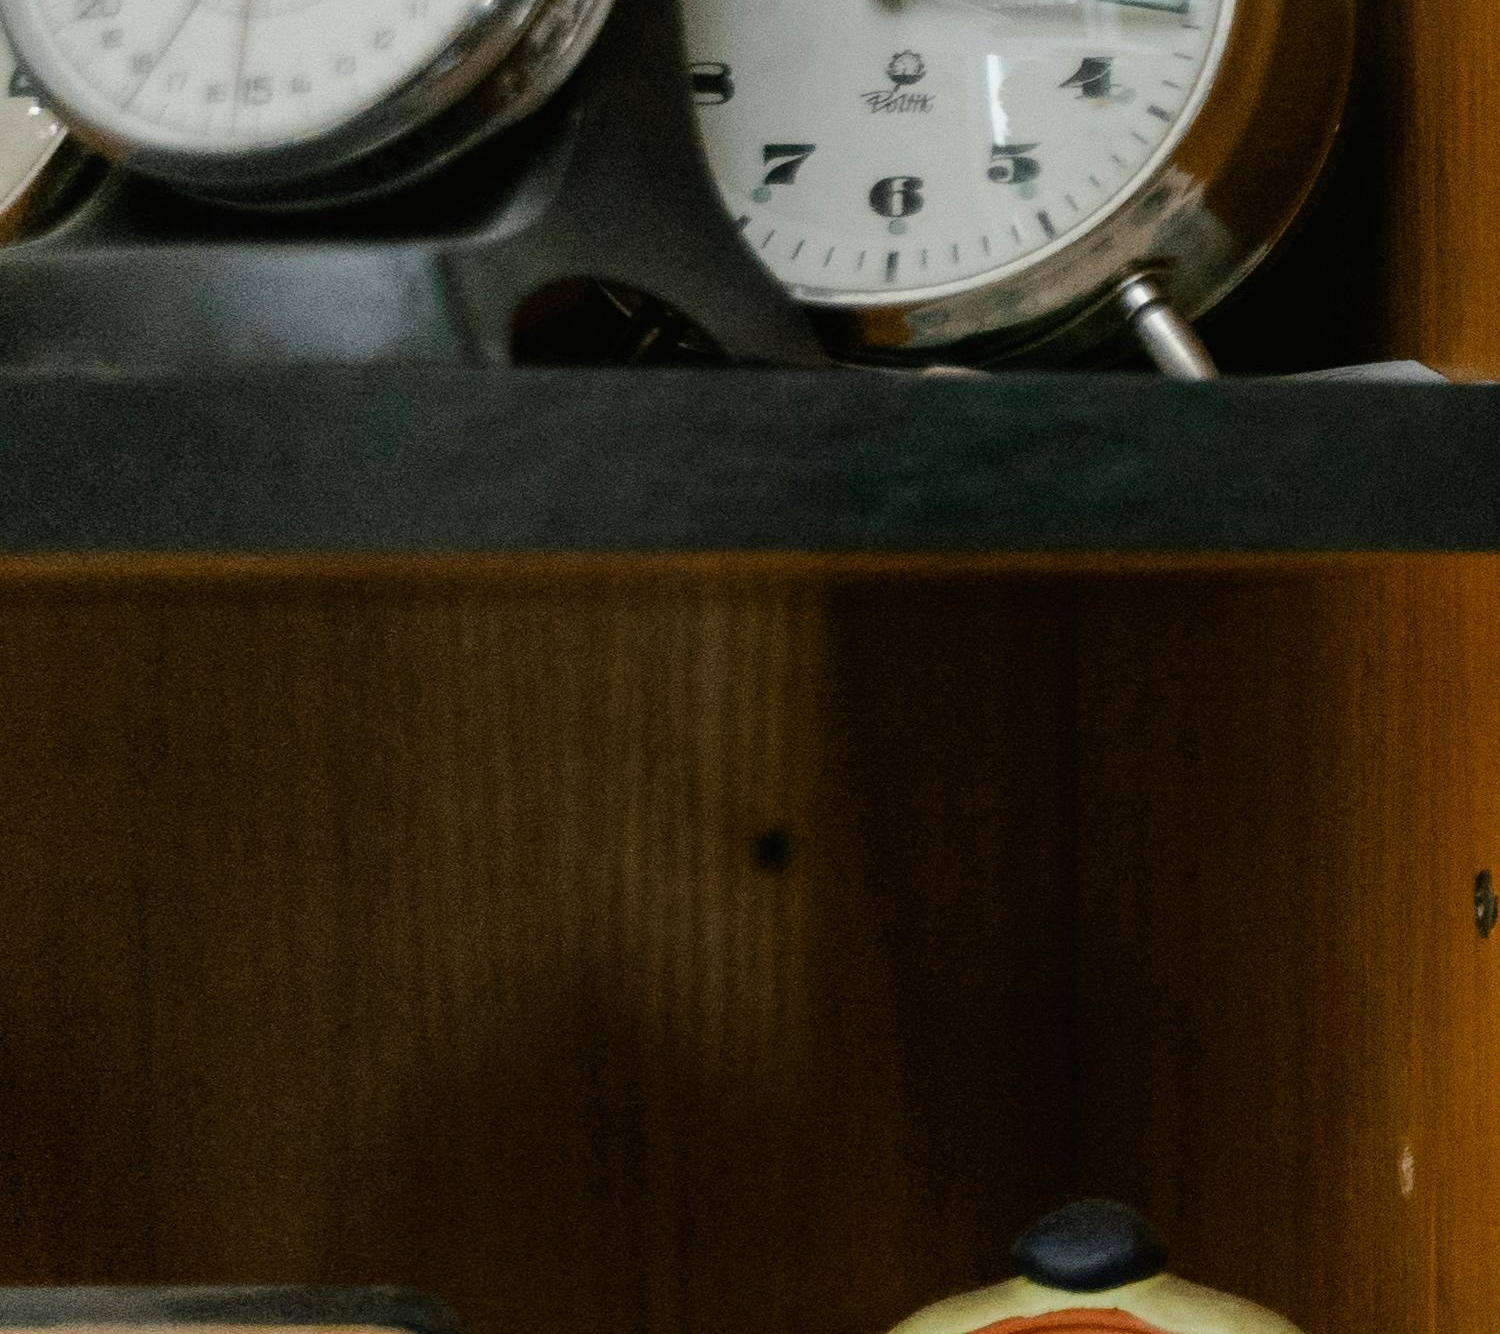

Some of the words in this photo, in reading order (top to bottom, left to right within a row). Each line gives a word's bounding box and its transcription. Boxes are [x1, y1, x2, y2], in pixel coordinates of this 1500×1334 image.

[1059, 56, 1116, 99] 4
[761, 143, 818, 186] 7
[986, 142, 1041, 185] 5
[868, 175, 925, 218] 6
